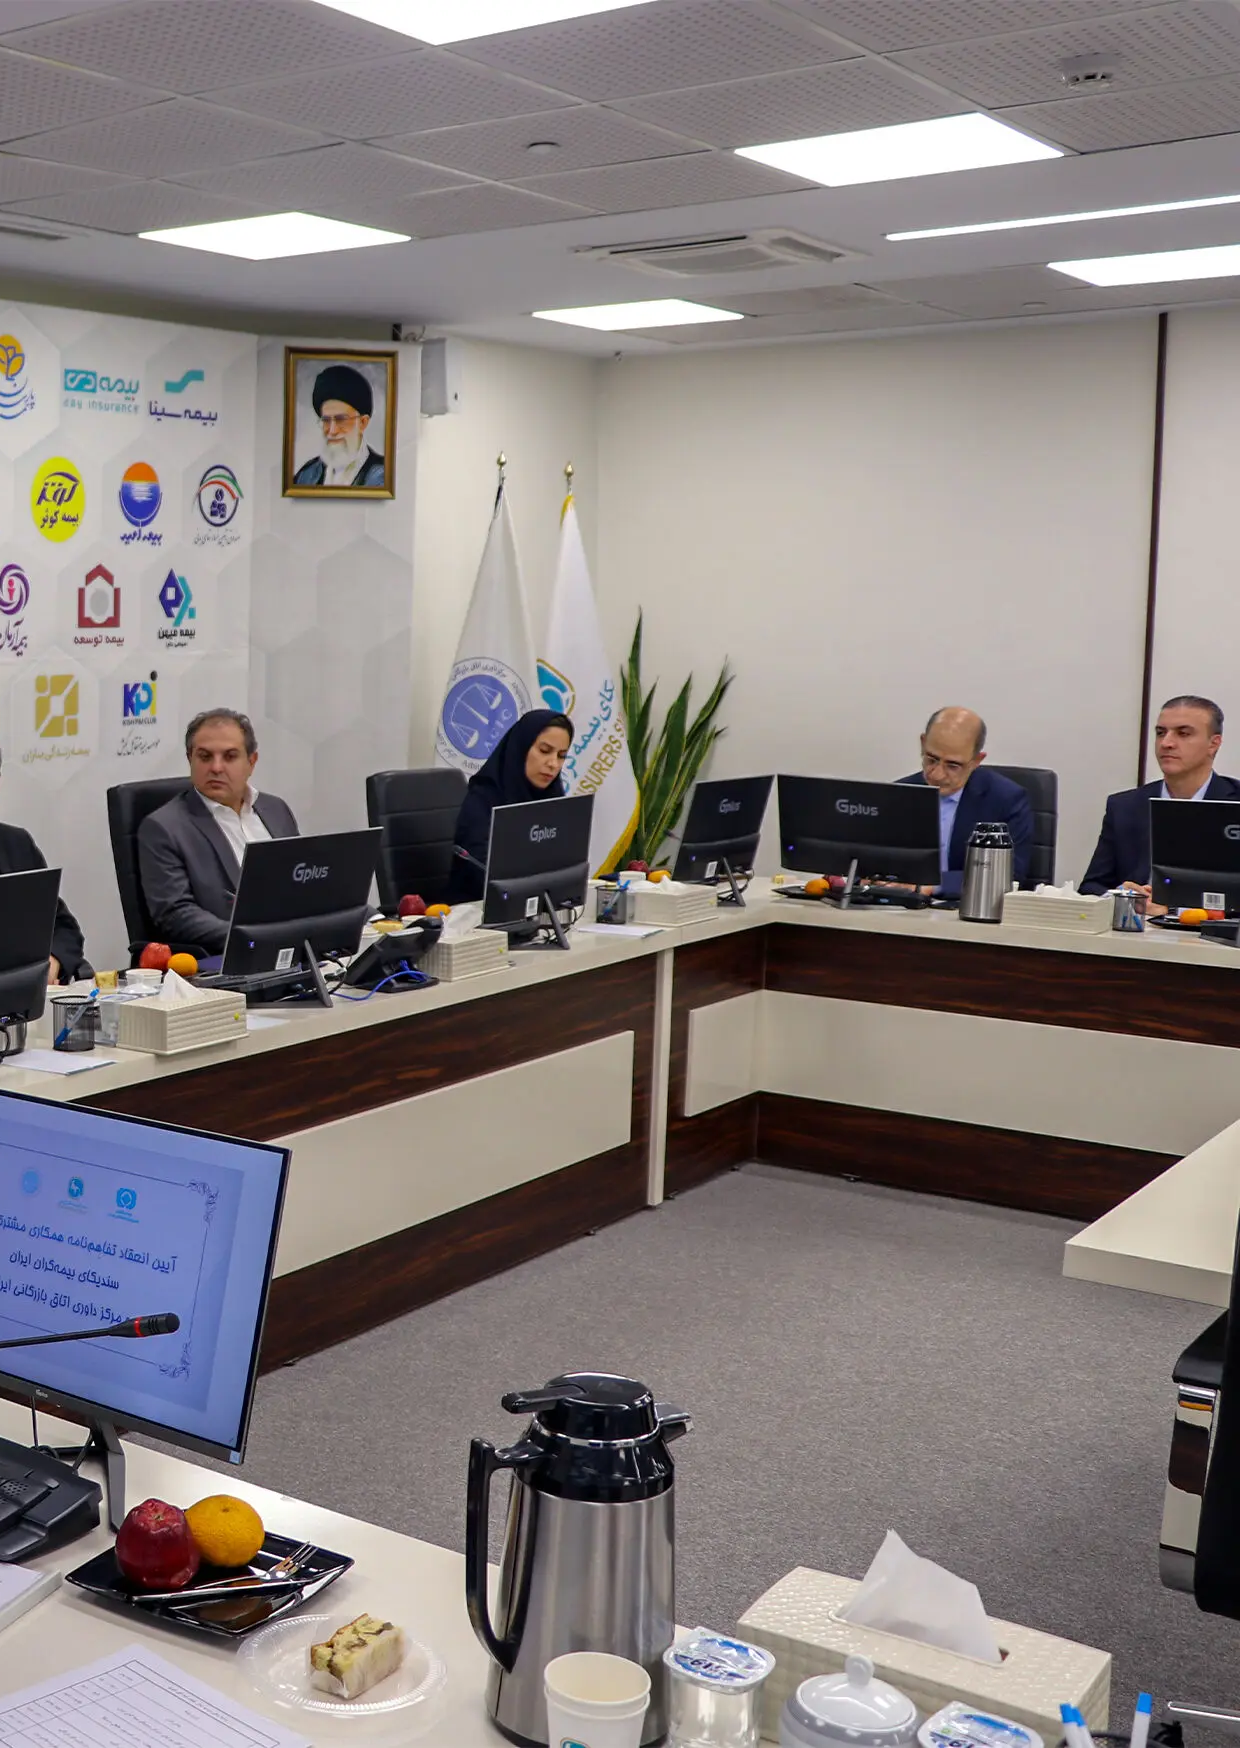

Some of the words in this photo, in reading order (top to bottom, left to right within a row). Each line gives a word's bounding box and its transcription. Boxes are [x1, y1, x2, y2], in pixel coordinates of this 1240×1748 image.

[100, 376, 140, 401] بیمه
[149, 400, 182, 421] سینا
[184, 409, 218, 426] بیمه
[73, 635, 104, 647] توسعه
[105, 636, 125, 647] بیمه
[719, 798, 741, 814] Gplus
[834, 798, 879, 817] Gplus
[530, 824, 557, 842] Gplus
[293, 862, 329, 883] Gplus
[28, 1225, 64, 1242] همکاری
[9, 1250, 32, 1267] ایران
[119, 1247, 149, 1265] انعقاد
[152, 1255, 177, 1274] آیین
[78, 1269, 119, 1290] سندیکای
[13, 1283, 48, 1305] بازرگانی
[49, 1293, 70, 1309] اتاق
[72, 1302, 97, 1316] داوری
[100, 1306, 122, 1324] مرکز
